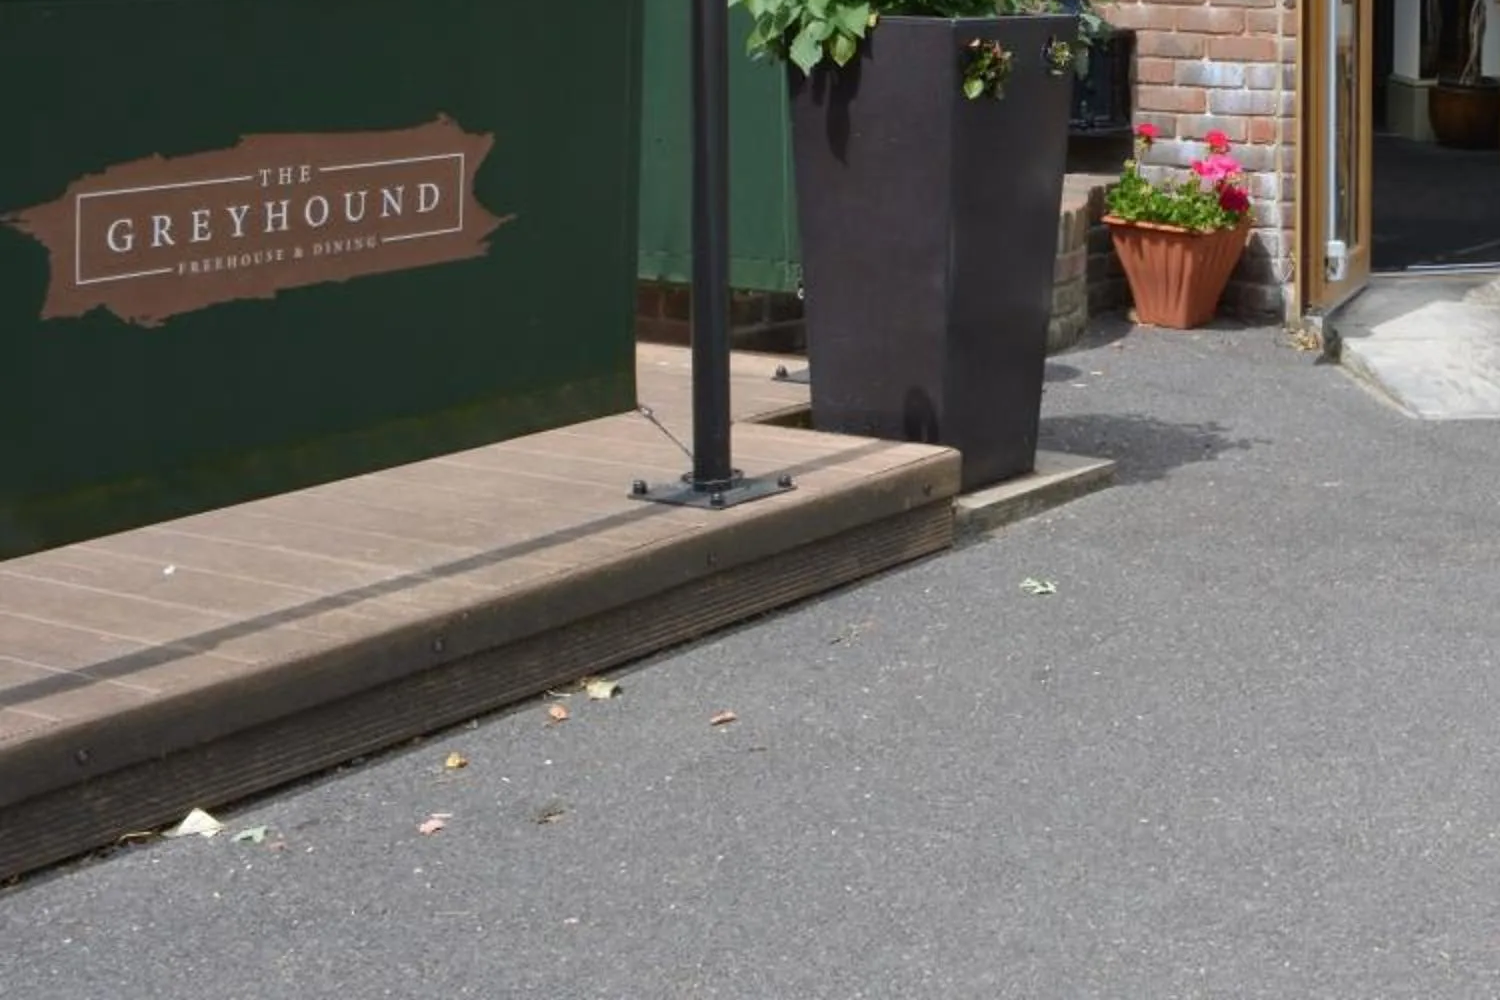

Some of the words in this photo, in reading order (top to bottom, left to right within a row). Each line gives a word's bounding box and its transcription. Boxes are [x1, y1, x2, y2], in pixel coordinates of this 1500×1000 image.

[259, 166, 312, 188] THE
[106, 183, 441, 253] GREYHOUND
[178, 250, 285, 275] FREEHOUSE
[294, 248, 304, 258] &
[313, 235, 378, 255] DINING
